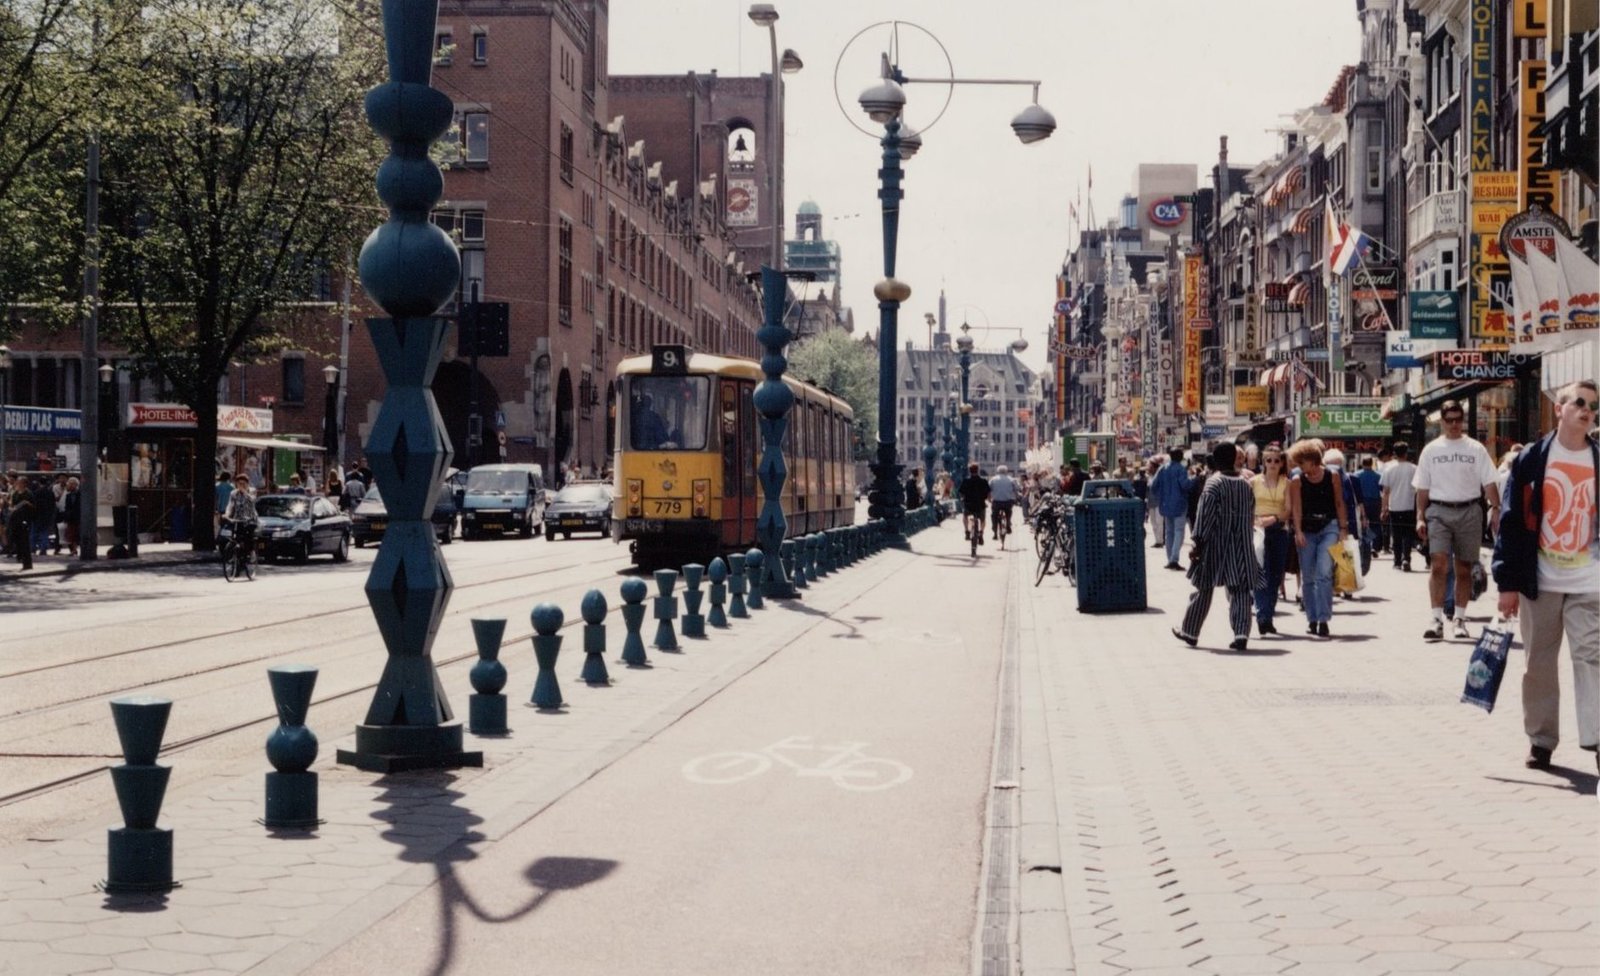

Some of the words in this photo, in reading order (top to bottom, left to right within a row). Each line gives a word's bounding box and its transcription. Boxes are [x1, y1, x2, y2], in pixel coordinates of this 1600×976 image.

[1478, 174, 1510, 184] CHINEES
[1474, 186, 1518, 198] RESTAURA
[1155, 204, 1180, 218] C&A
[1353, 270, 1396, 286] Grand
[1422, 325, 1447, 334] Change
[663, 351, 676, 367] 9
[1441, 352, 1487, 364] HOTEL
[1493, 352, 1527, 365] INFO
[1452, 365, 1516, 378] CHANGE
[1161, 344, 1172, 415] HOTEL
[31, 412, 52, 432] PLAS
[1325, 410, 1382, 423] TELEFO
[1432, 452, 1476, 465] nautica
[654, 502, 682, 514] 779
